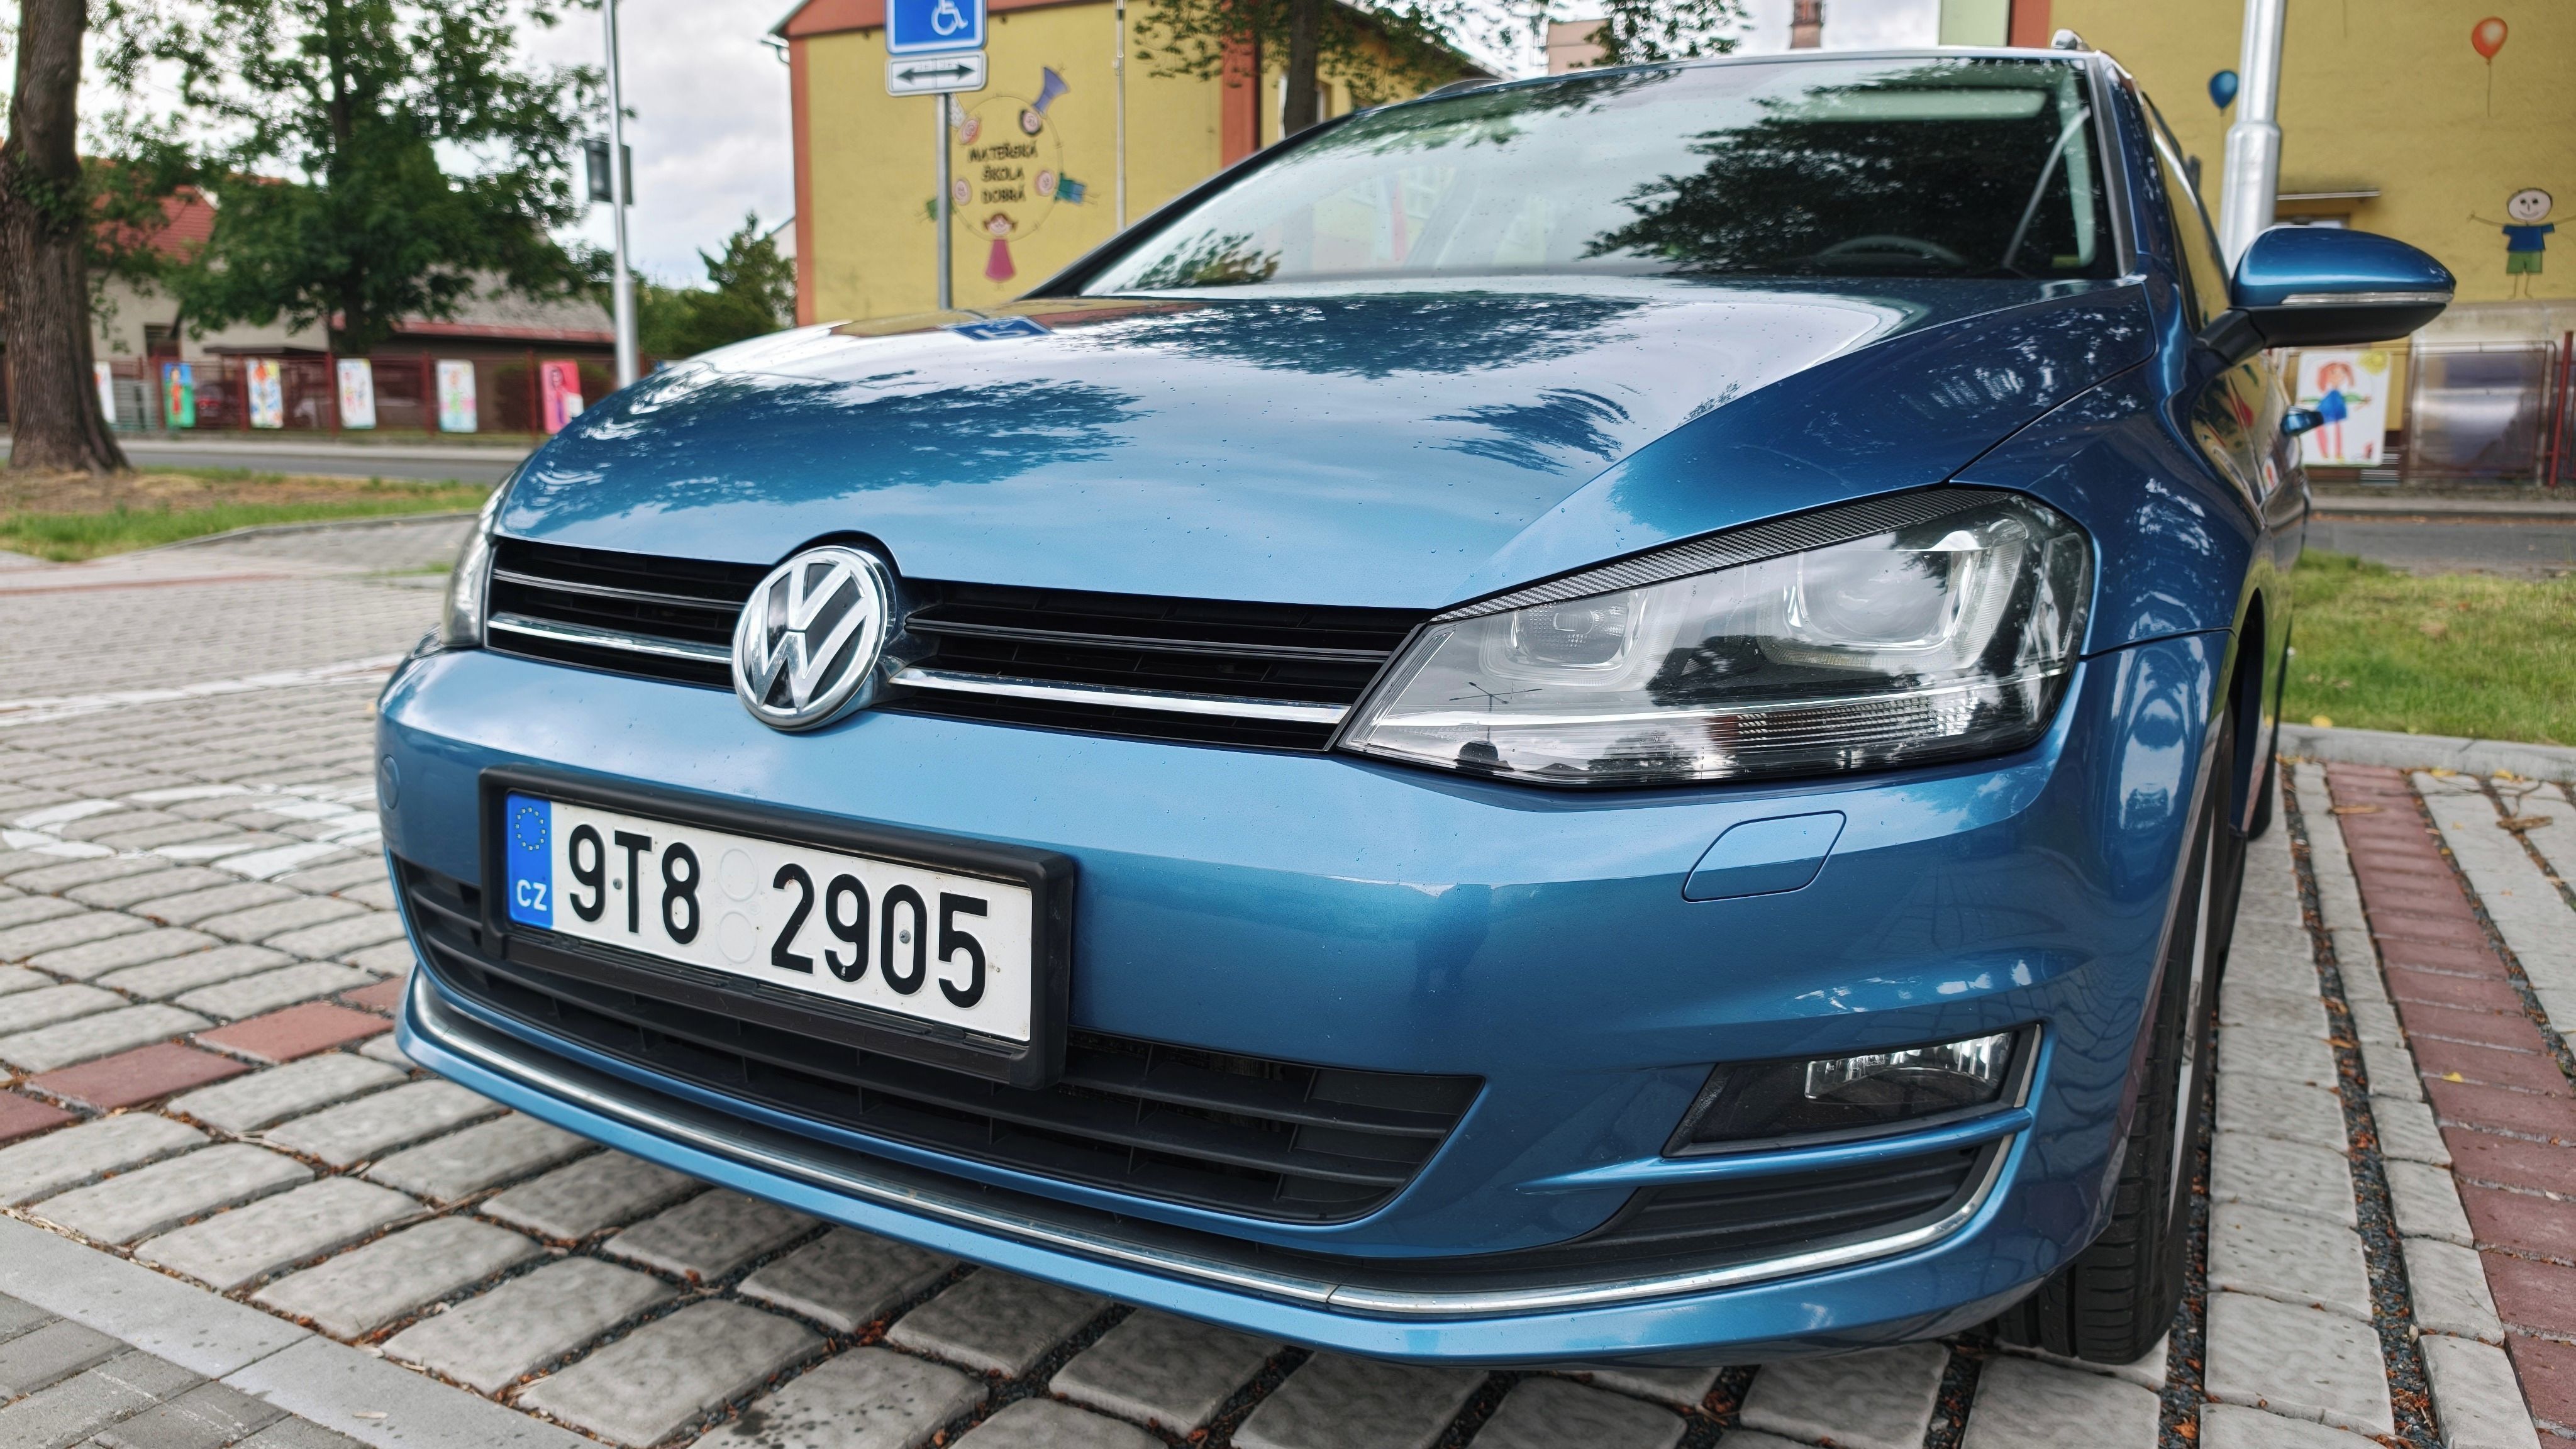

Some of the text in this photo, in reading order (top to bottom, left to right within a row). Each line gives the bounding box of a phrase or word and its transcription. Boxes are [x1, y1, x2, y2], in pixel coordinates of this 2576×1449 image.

[516, 879, 548, 911] CZ
[569, 824, 989, 1008] 9T8 2905
